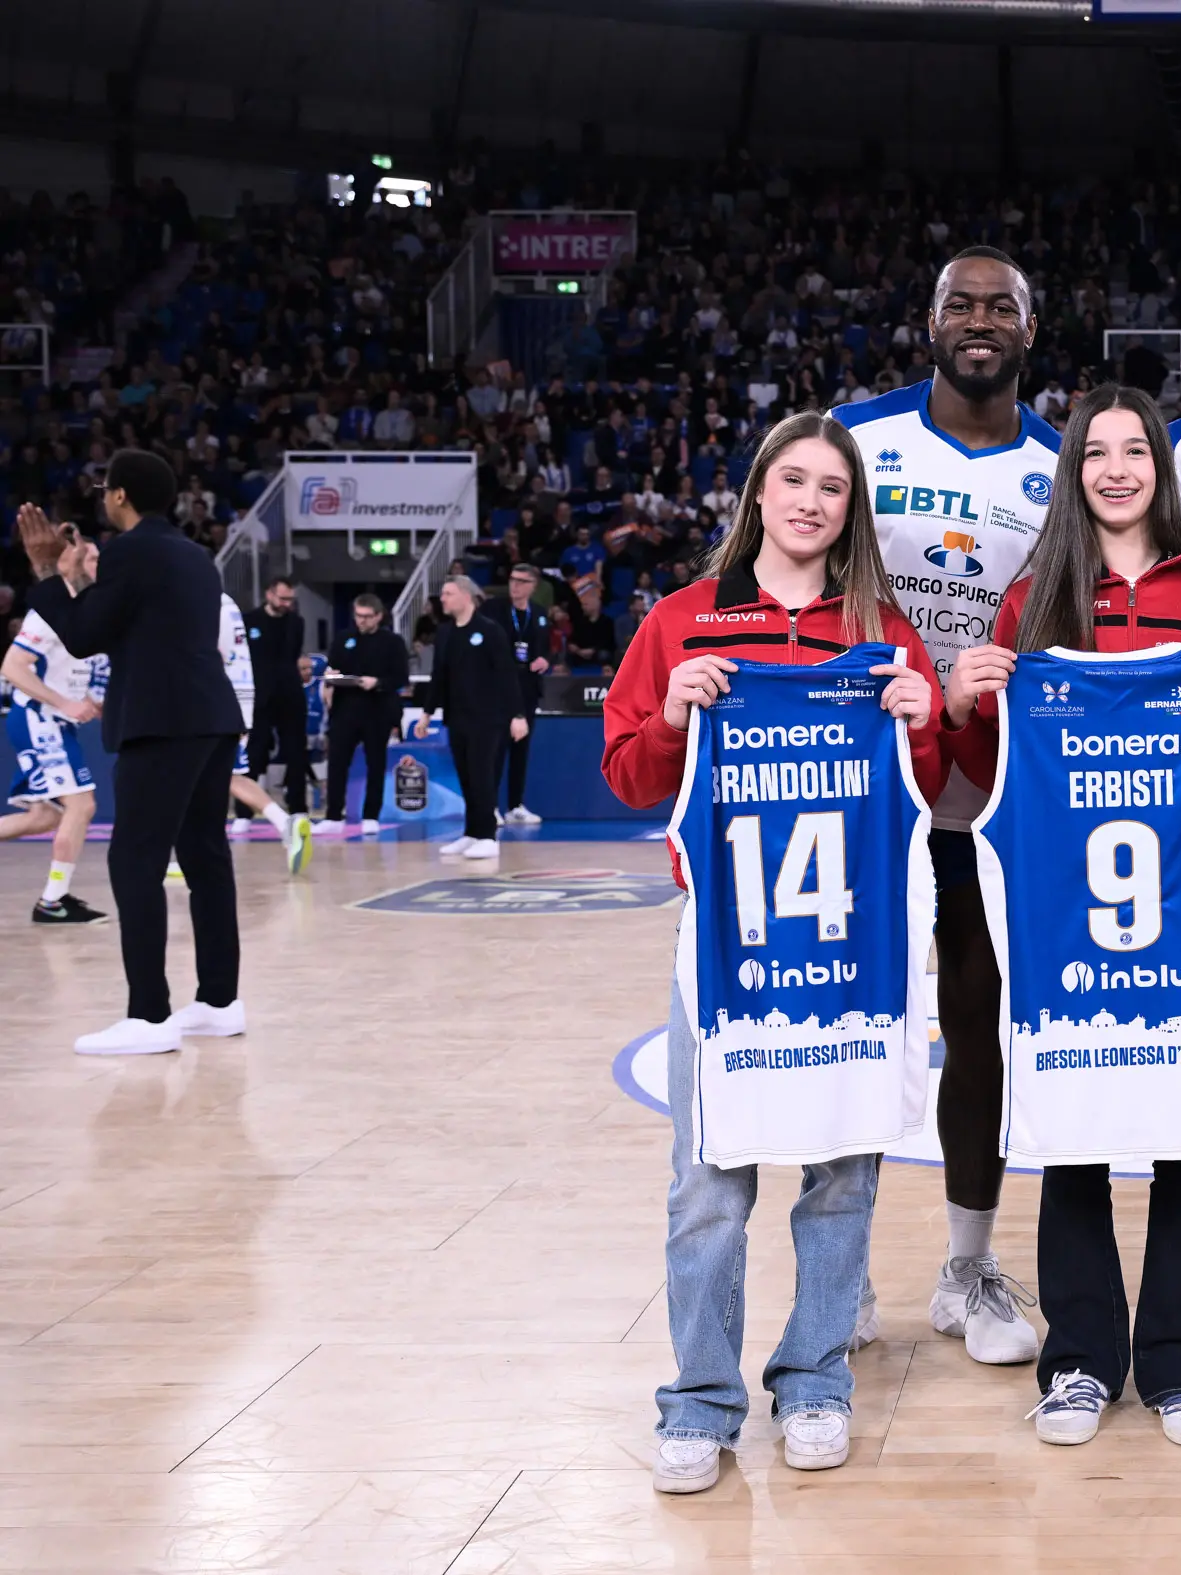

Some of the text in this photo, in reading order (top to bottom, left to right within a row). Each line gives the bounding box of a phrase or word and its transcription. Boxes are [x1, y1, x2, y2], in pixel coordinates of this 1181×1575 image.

[910, 486, 979, 521] BTL
[992, 505, 1016, 518] BANCA
[990, 519, 1028, 535] LOMBARDO
[991, 512, 1005, 522] DEL
[695, 612, 766, 623] GIVOVA
[933, 640, 966, 650] solutions
[727, 697, 745, 705] ZANI
[808, 690, 875, 699] BERNARDELLI
[722, 721, 854, 749] bonera.
[1069, 768, 1174, 809] ERBISTI
[725, 810, 854, 947] 14
[1086, 819, 1163, 952] 9
[771, 959, 857, 988] inblu
[724, 1039, 887, 1073] BRESCIA LEONESSA D'ITALIA
[1036, 1048, 1092, 1071] BRESCIA
[1094, 1045, 1165, 1067] LEONESSA
